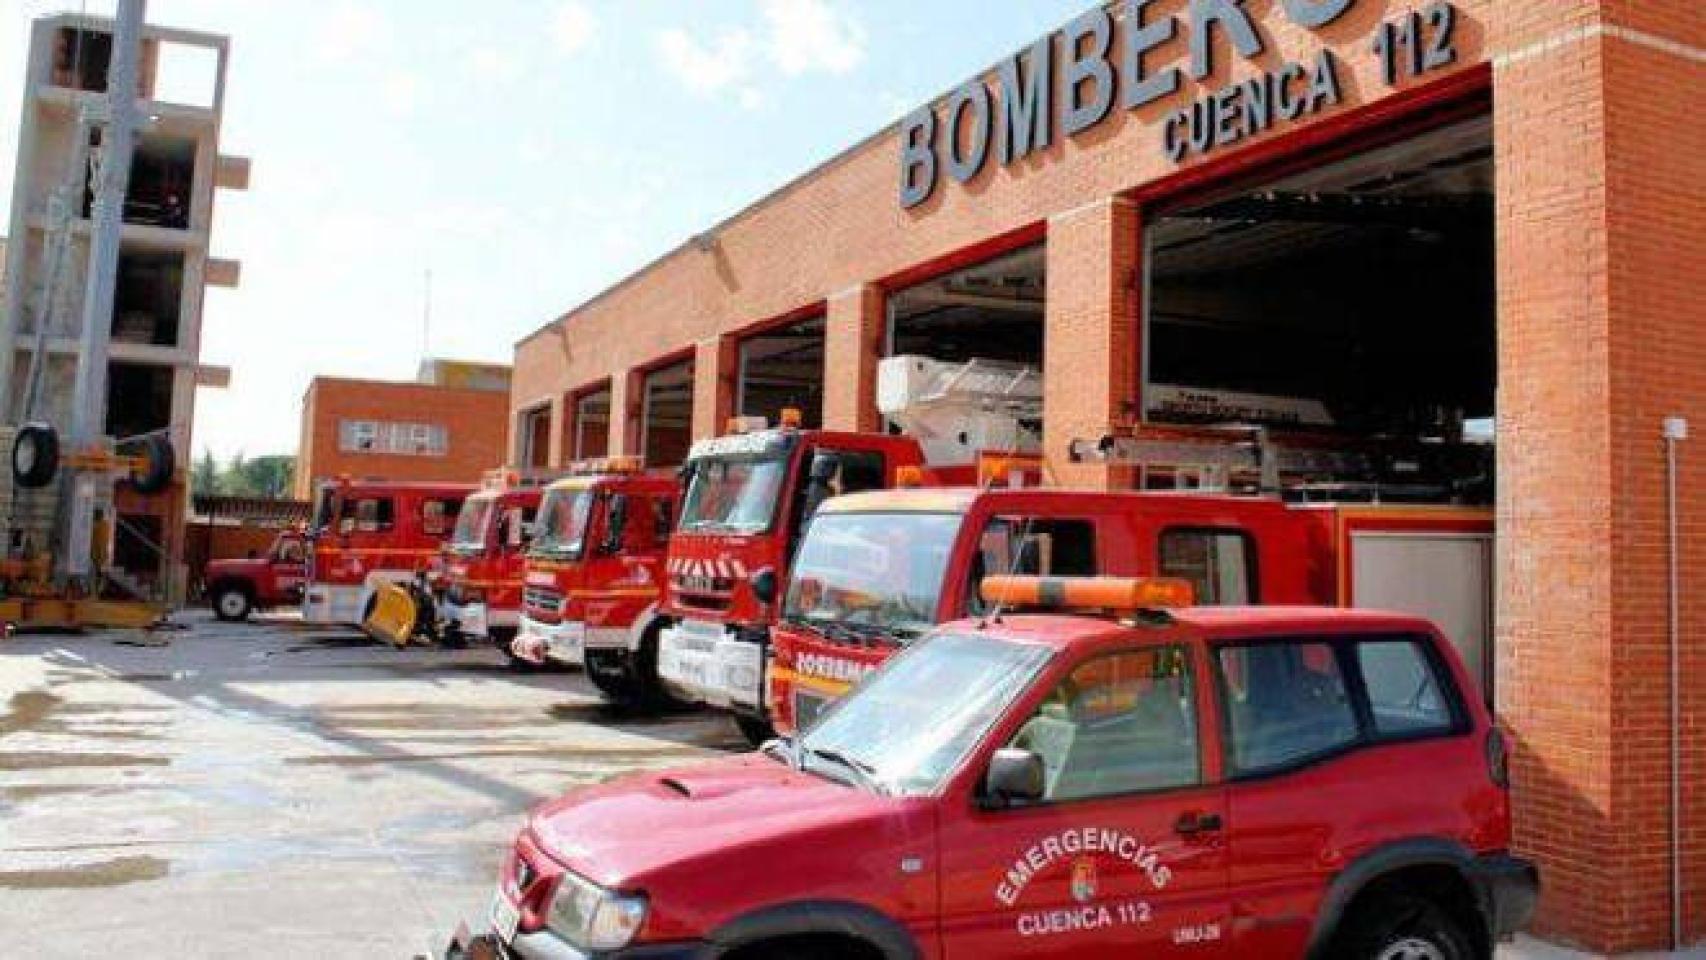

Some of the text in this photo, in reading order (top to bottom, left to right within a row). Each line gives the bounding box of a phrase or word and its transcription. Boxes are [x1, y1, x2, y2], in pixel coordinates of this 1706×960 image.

[900, 0, 1354, 208] BOMBER
[1164, 3, 1457, 162] CUENCA 112
[995, 828, 1172, 905] EMERGENCIAS
[1017, 902, 1151, 936] CUENCA 112
